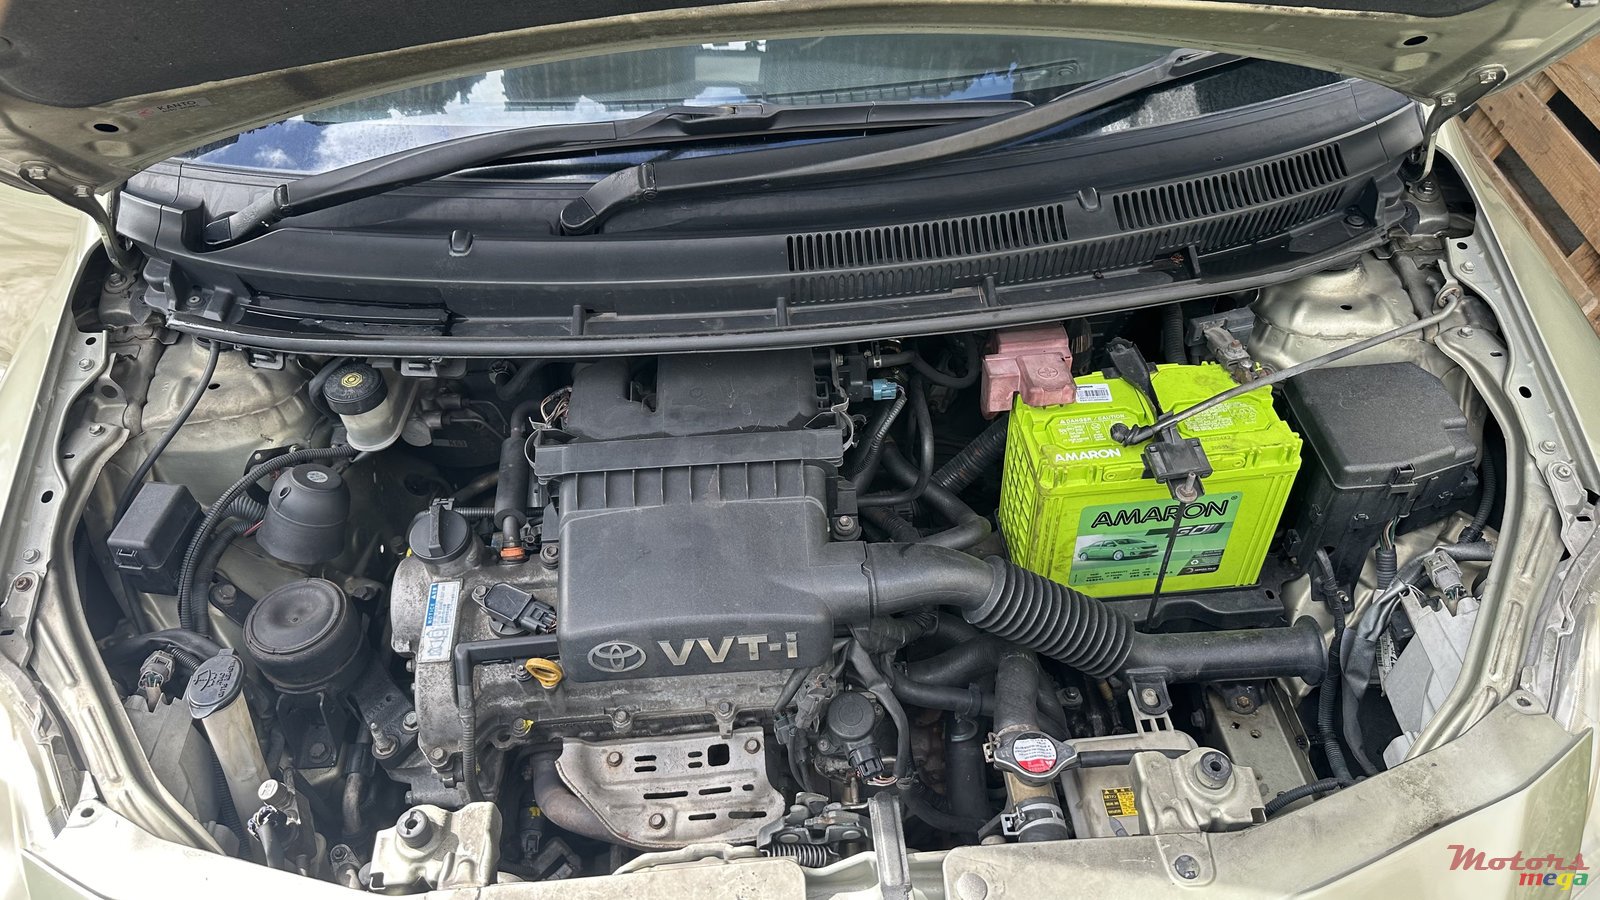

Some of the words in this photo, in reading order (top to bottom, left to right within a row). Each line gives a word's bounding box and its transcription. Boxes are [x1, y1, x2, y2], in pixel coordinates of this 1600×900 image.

[1055, 448, 1122, 463] AMARON
[1091, 499, 1229, 529] AMARON
[657, 631, 798, 666] VVT-i
